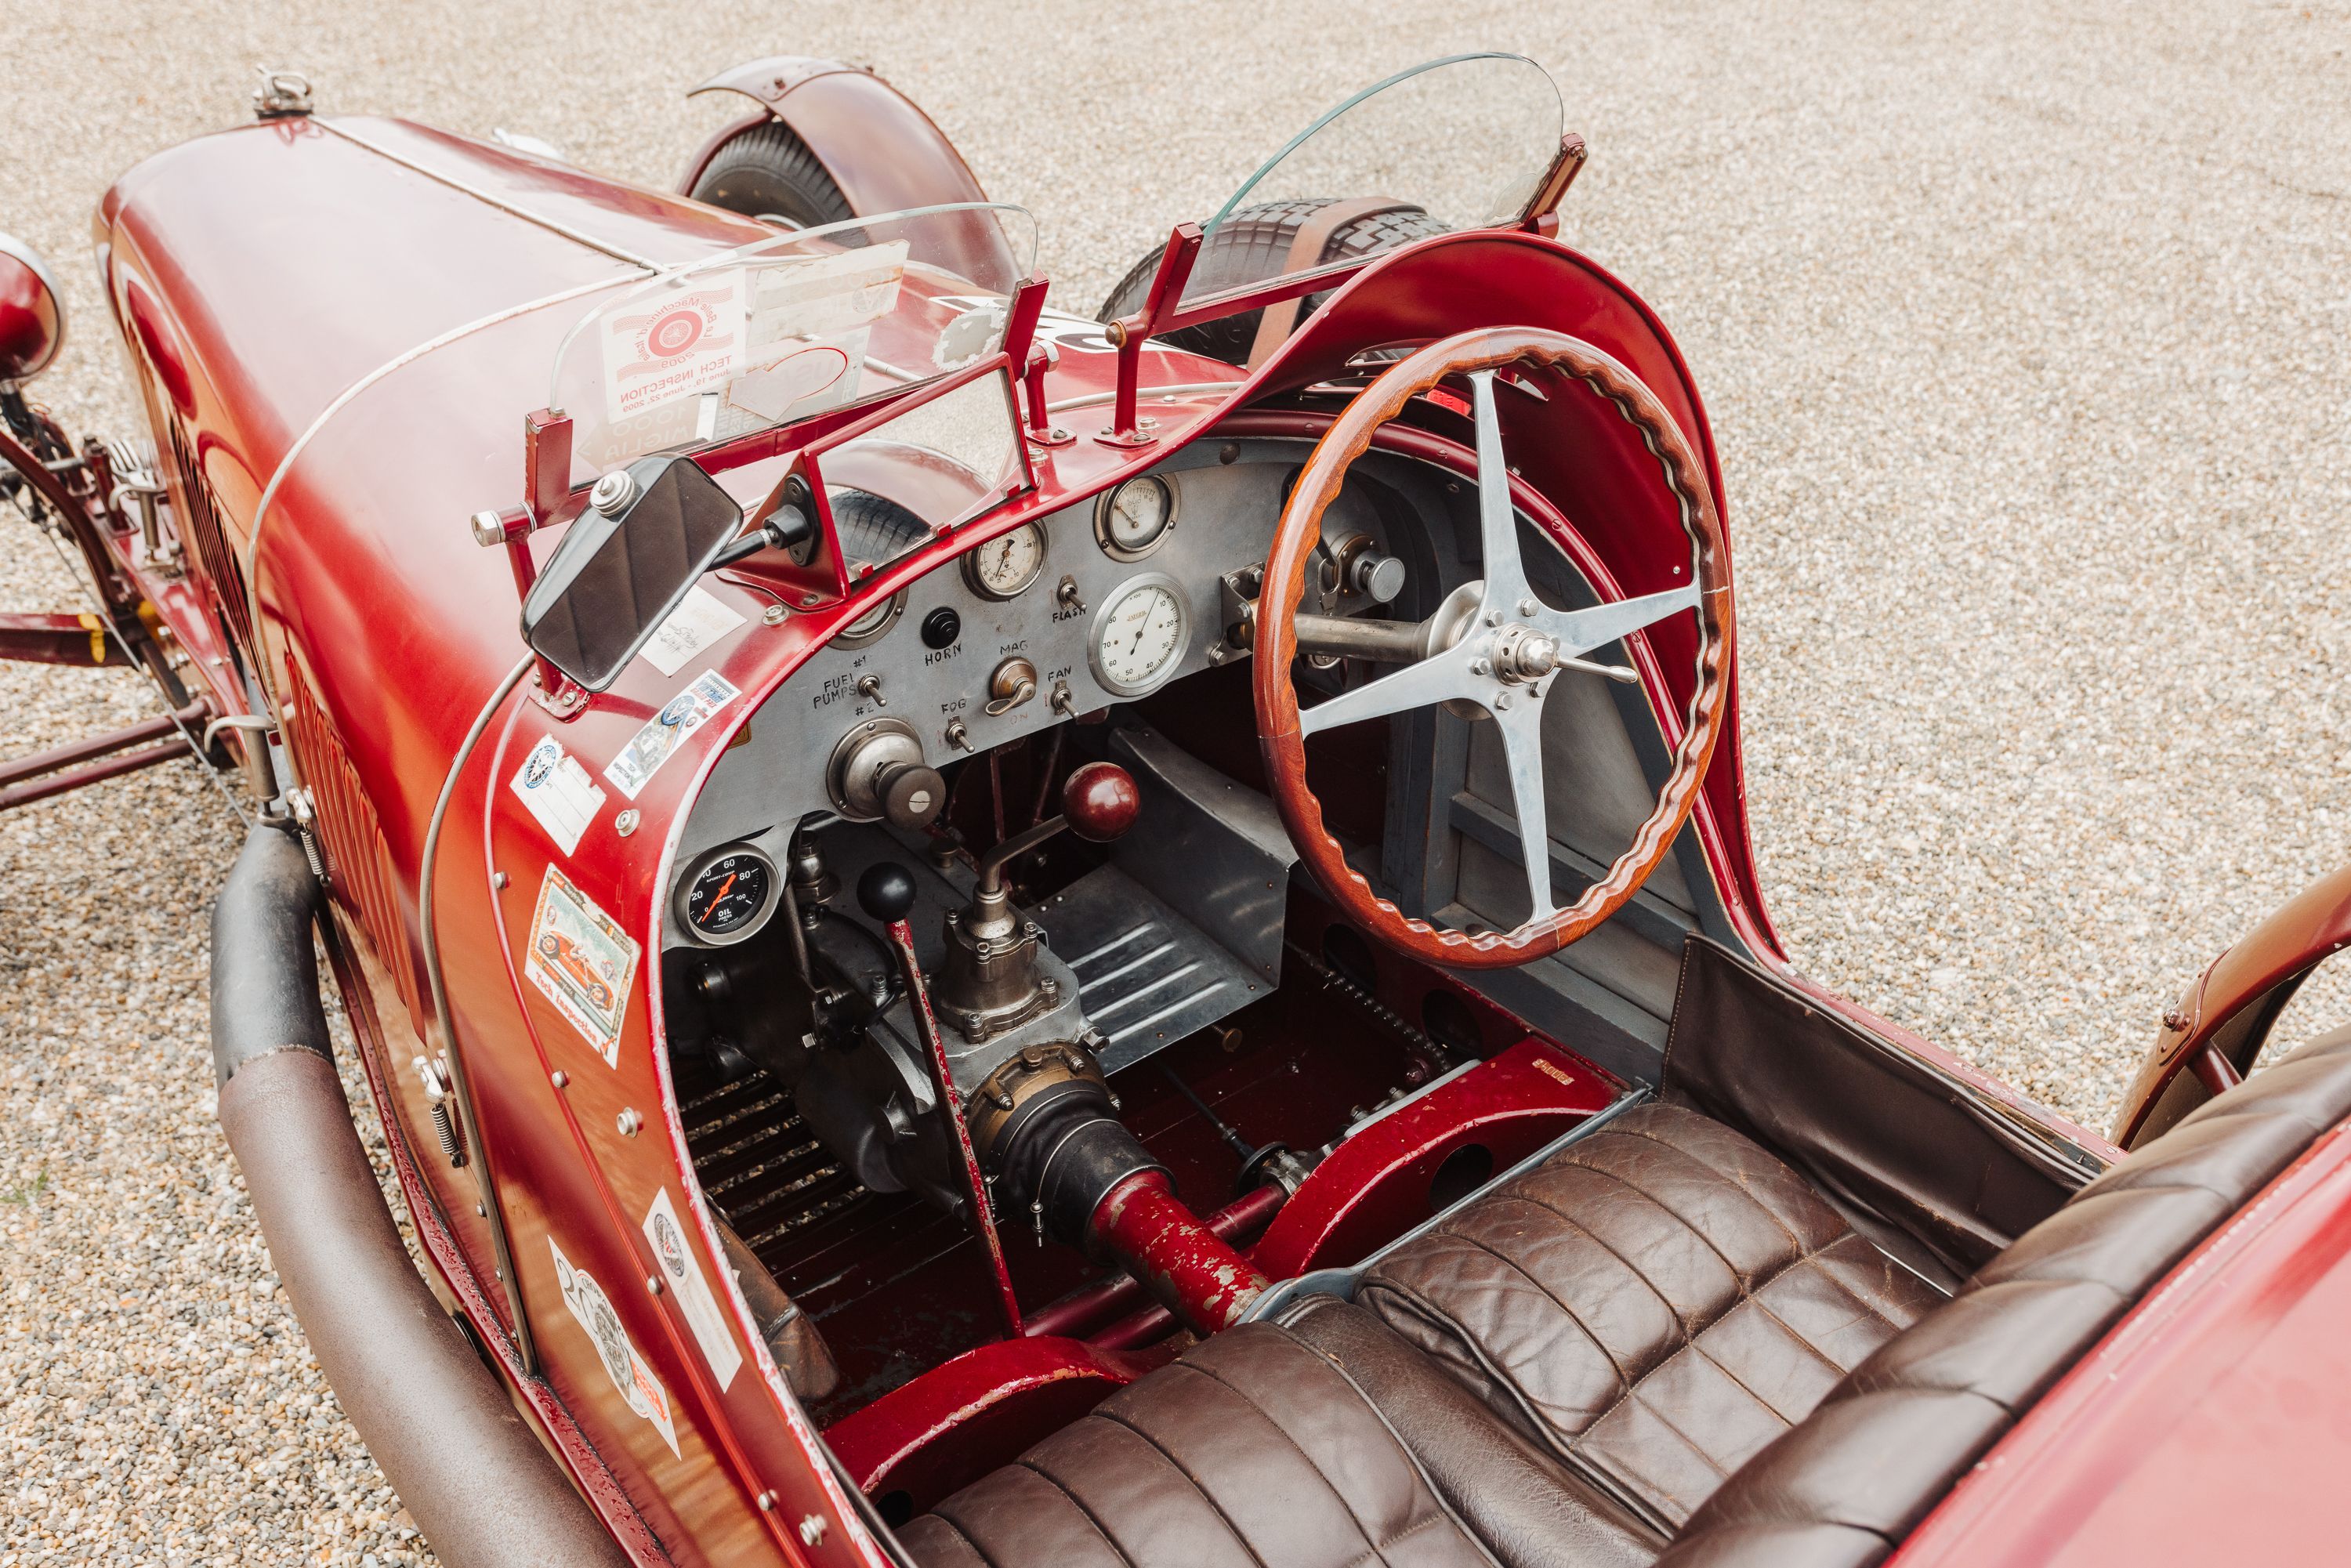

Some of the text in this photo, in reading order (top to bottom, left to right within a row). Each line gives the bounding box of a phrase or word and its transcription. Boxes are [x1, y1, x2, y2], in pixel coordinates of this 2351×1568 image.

[1052, 607, 1086, 624] FLASH
[1127, 610, 1147, 621] JAEGER
[1166, 619, 1174, 628] 20
[1000, 640, 1029, 655] MAG
[925, 643, 962, 667] HORN
[1109, 659, 1117, 668] 60
[1048, 665, 1071, 683] FAN
[813, 686, 859, 709] PUMPS
[940, 698, 967, 715] FOG
[1009, 714, 1029, 724] ON
[723, 859, 735, 869] 60
[739, 871, 751, 881] 80
[691, 890, 703, 901] 20
[718, 908, 732, 918] OIL
